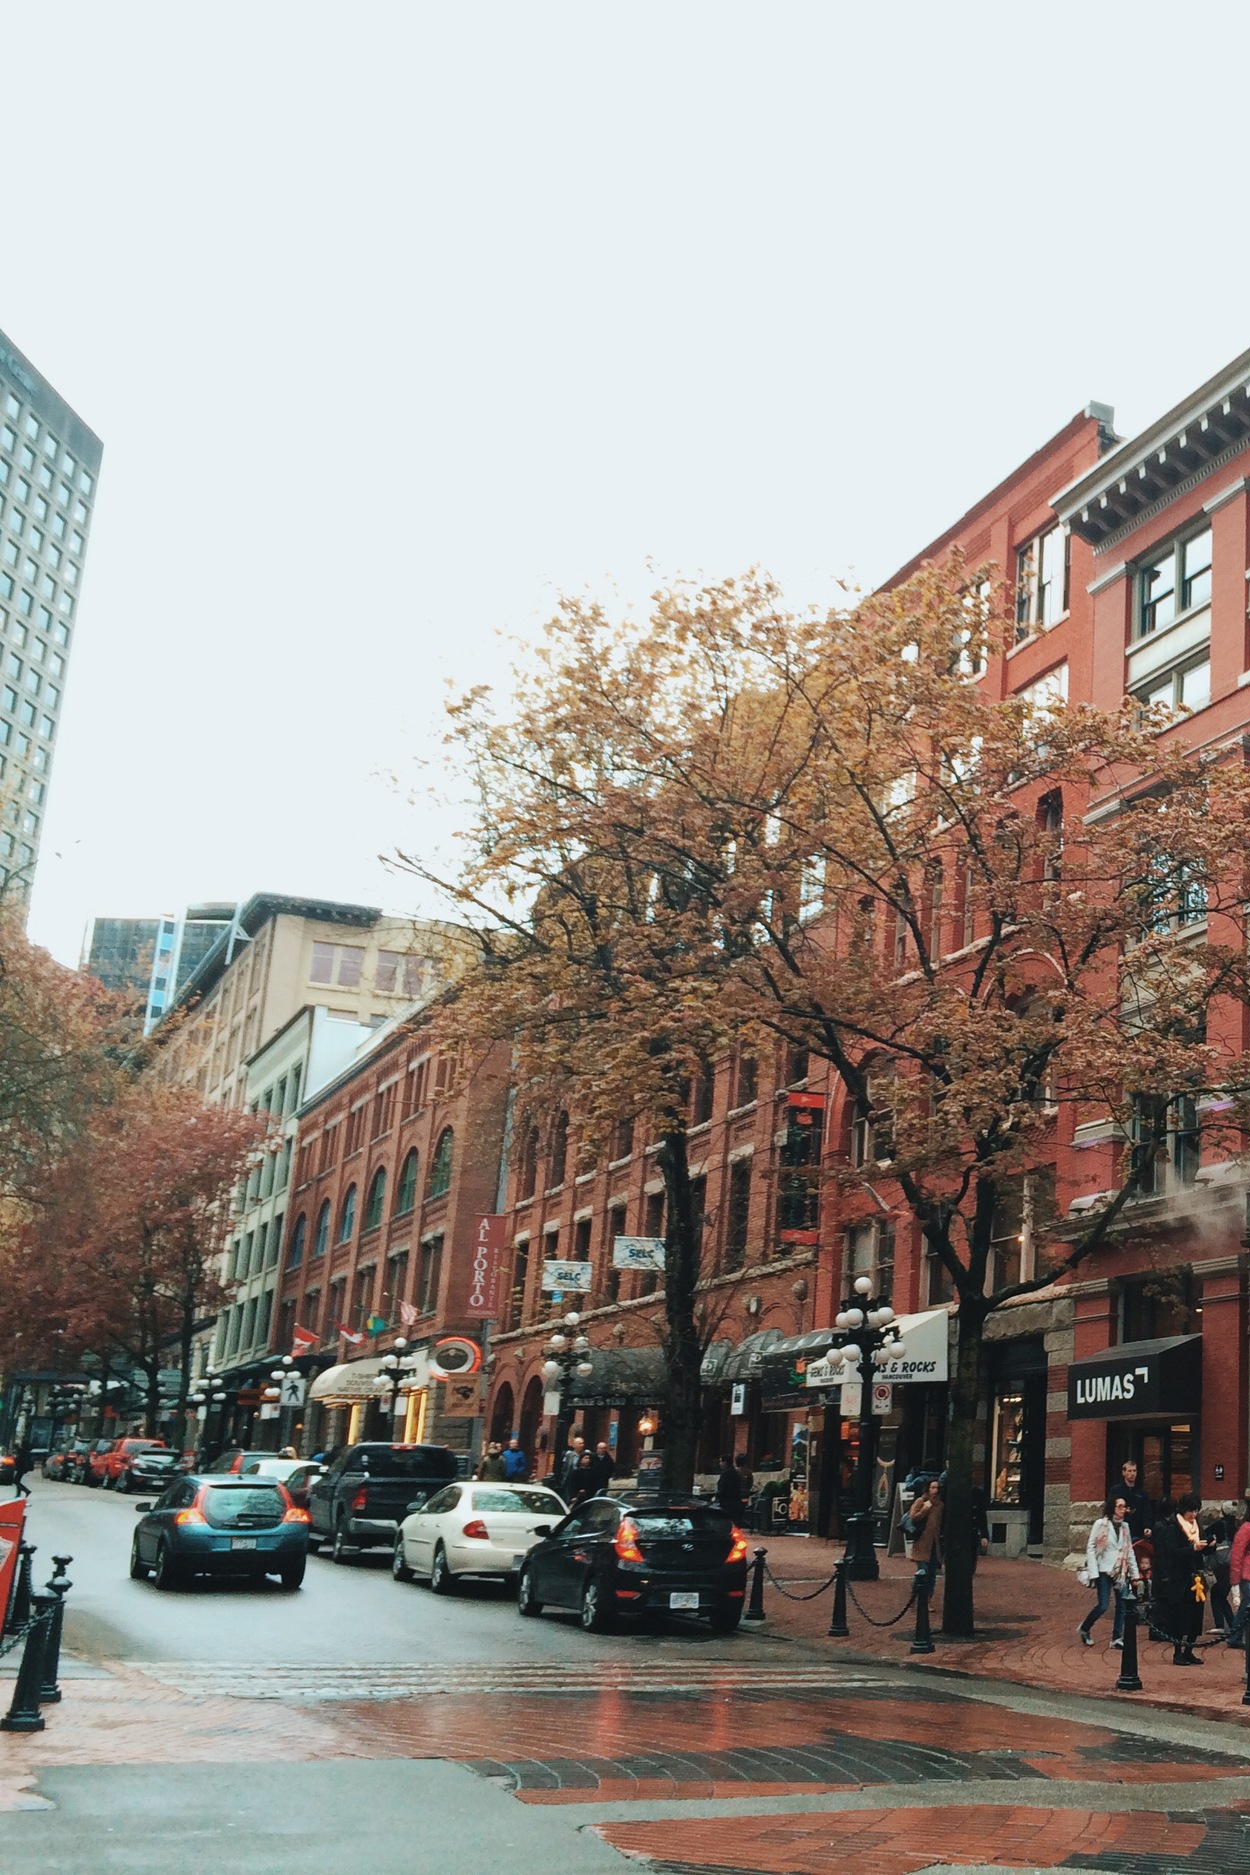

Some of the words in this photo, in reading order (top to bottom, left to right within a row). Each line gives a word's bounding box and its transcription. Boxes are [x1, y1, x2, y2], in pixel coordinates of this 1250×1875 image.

[479, 1218, 490, 1242] AL
[470, 1247, 488, 1307] PORTO
[890, 1361, 898, 1373] &
[901, 1361, 937, 1373] ROCKS
[1076, 1373, 1136, 1404] LUMAS
